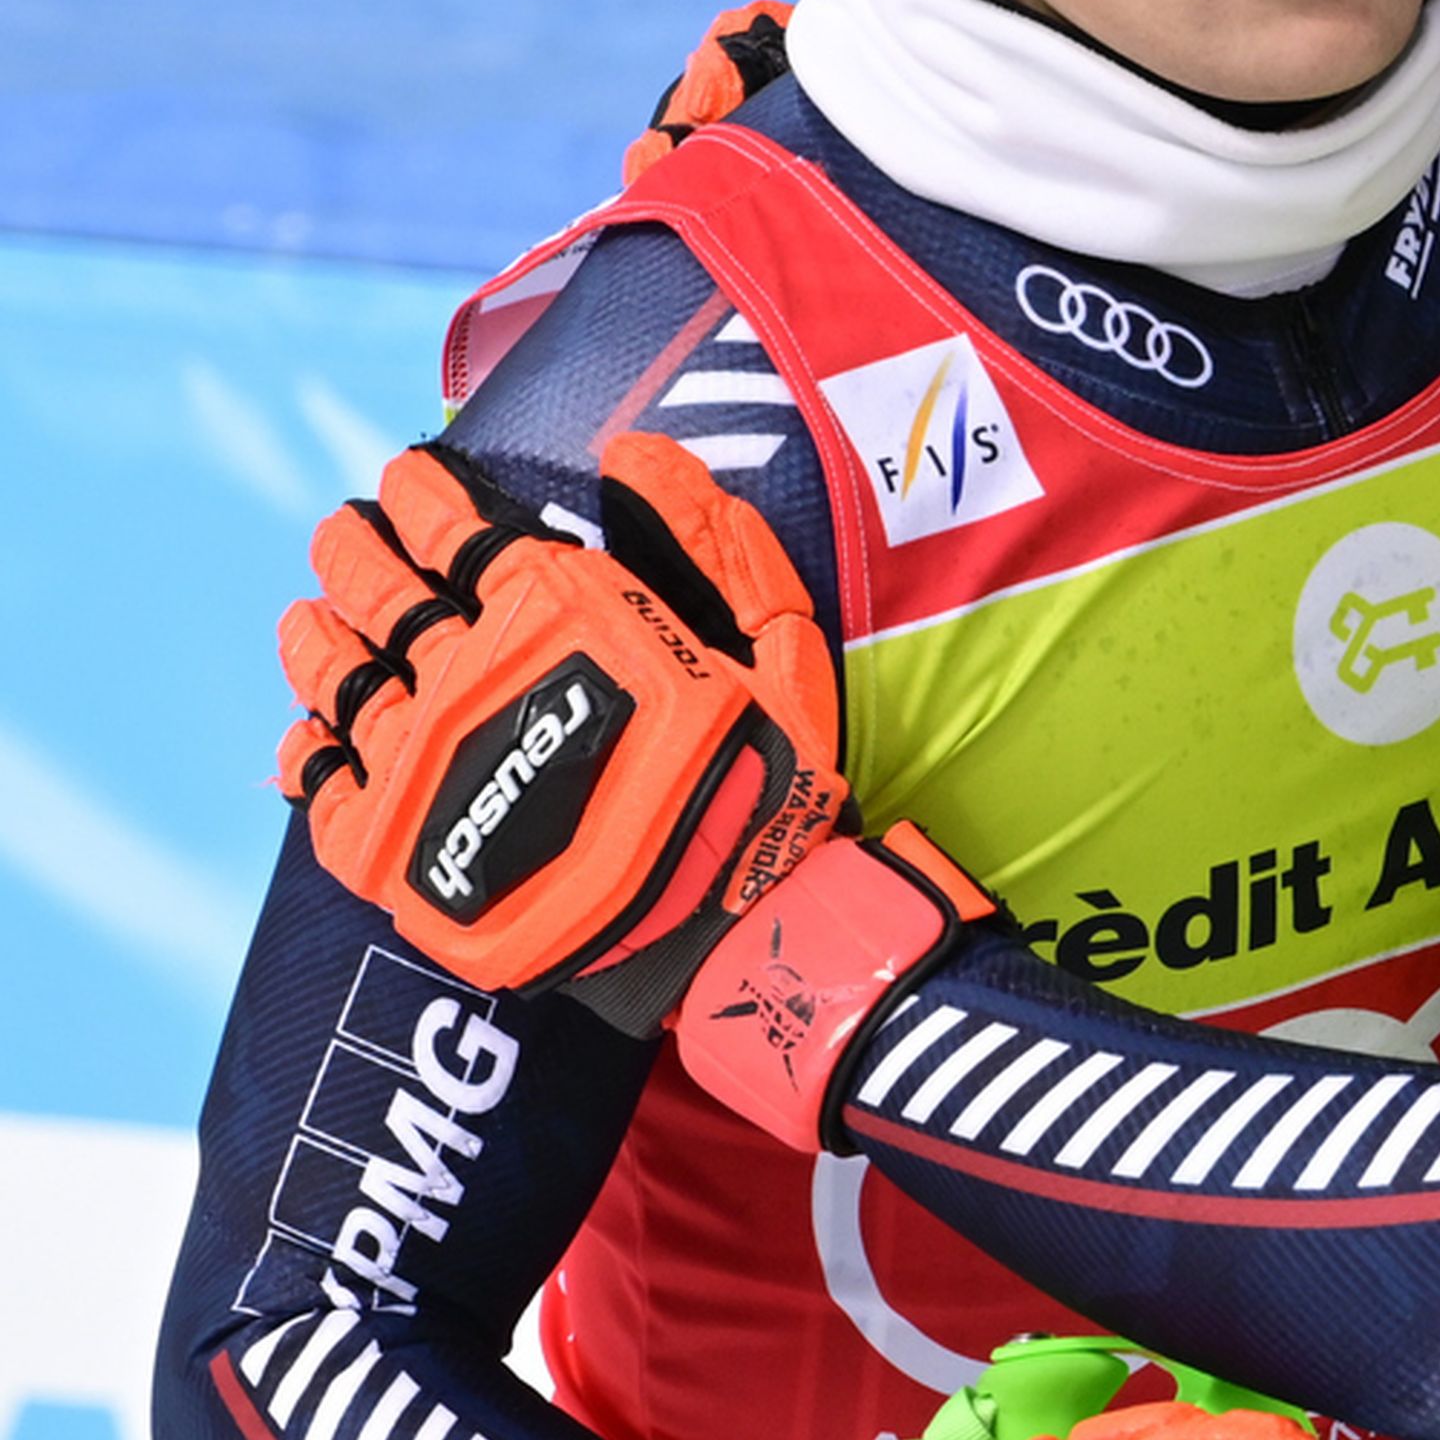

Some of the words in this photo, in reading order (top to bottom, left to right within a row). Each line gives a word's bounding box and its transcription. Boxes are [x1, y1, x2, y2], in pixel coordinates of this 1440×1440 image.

[877, 423, 999, 493] FIS
[621, 588, 712, 680] racing
[428, 683, 592, 902] reusch
[1018, 841, 1332, 983] rèdit
